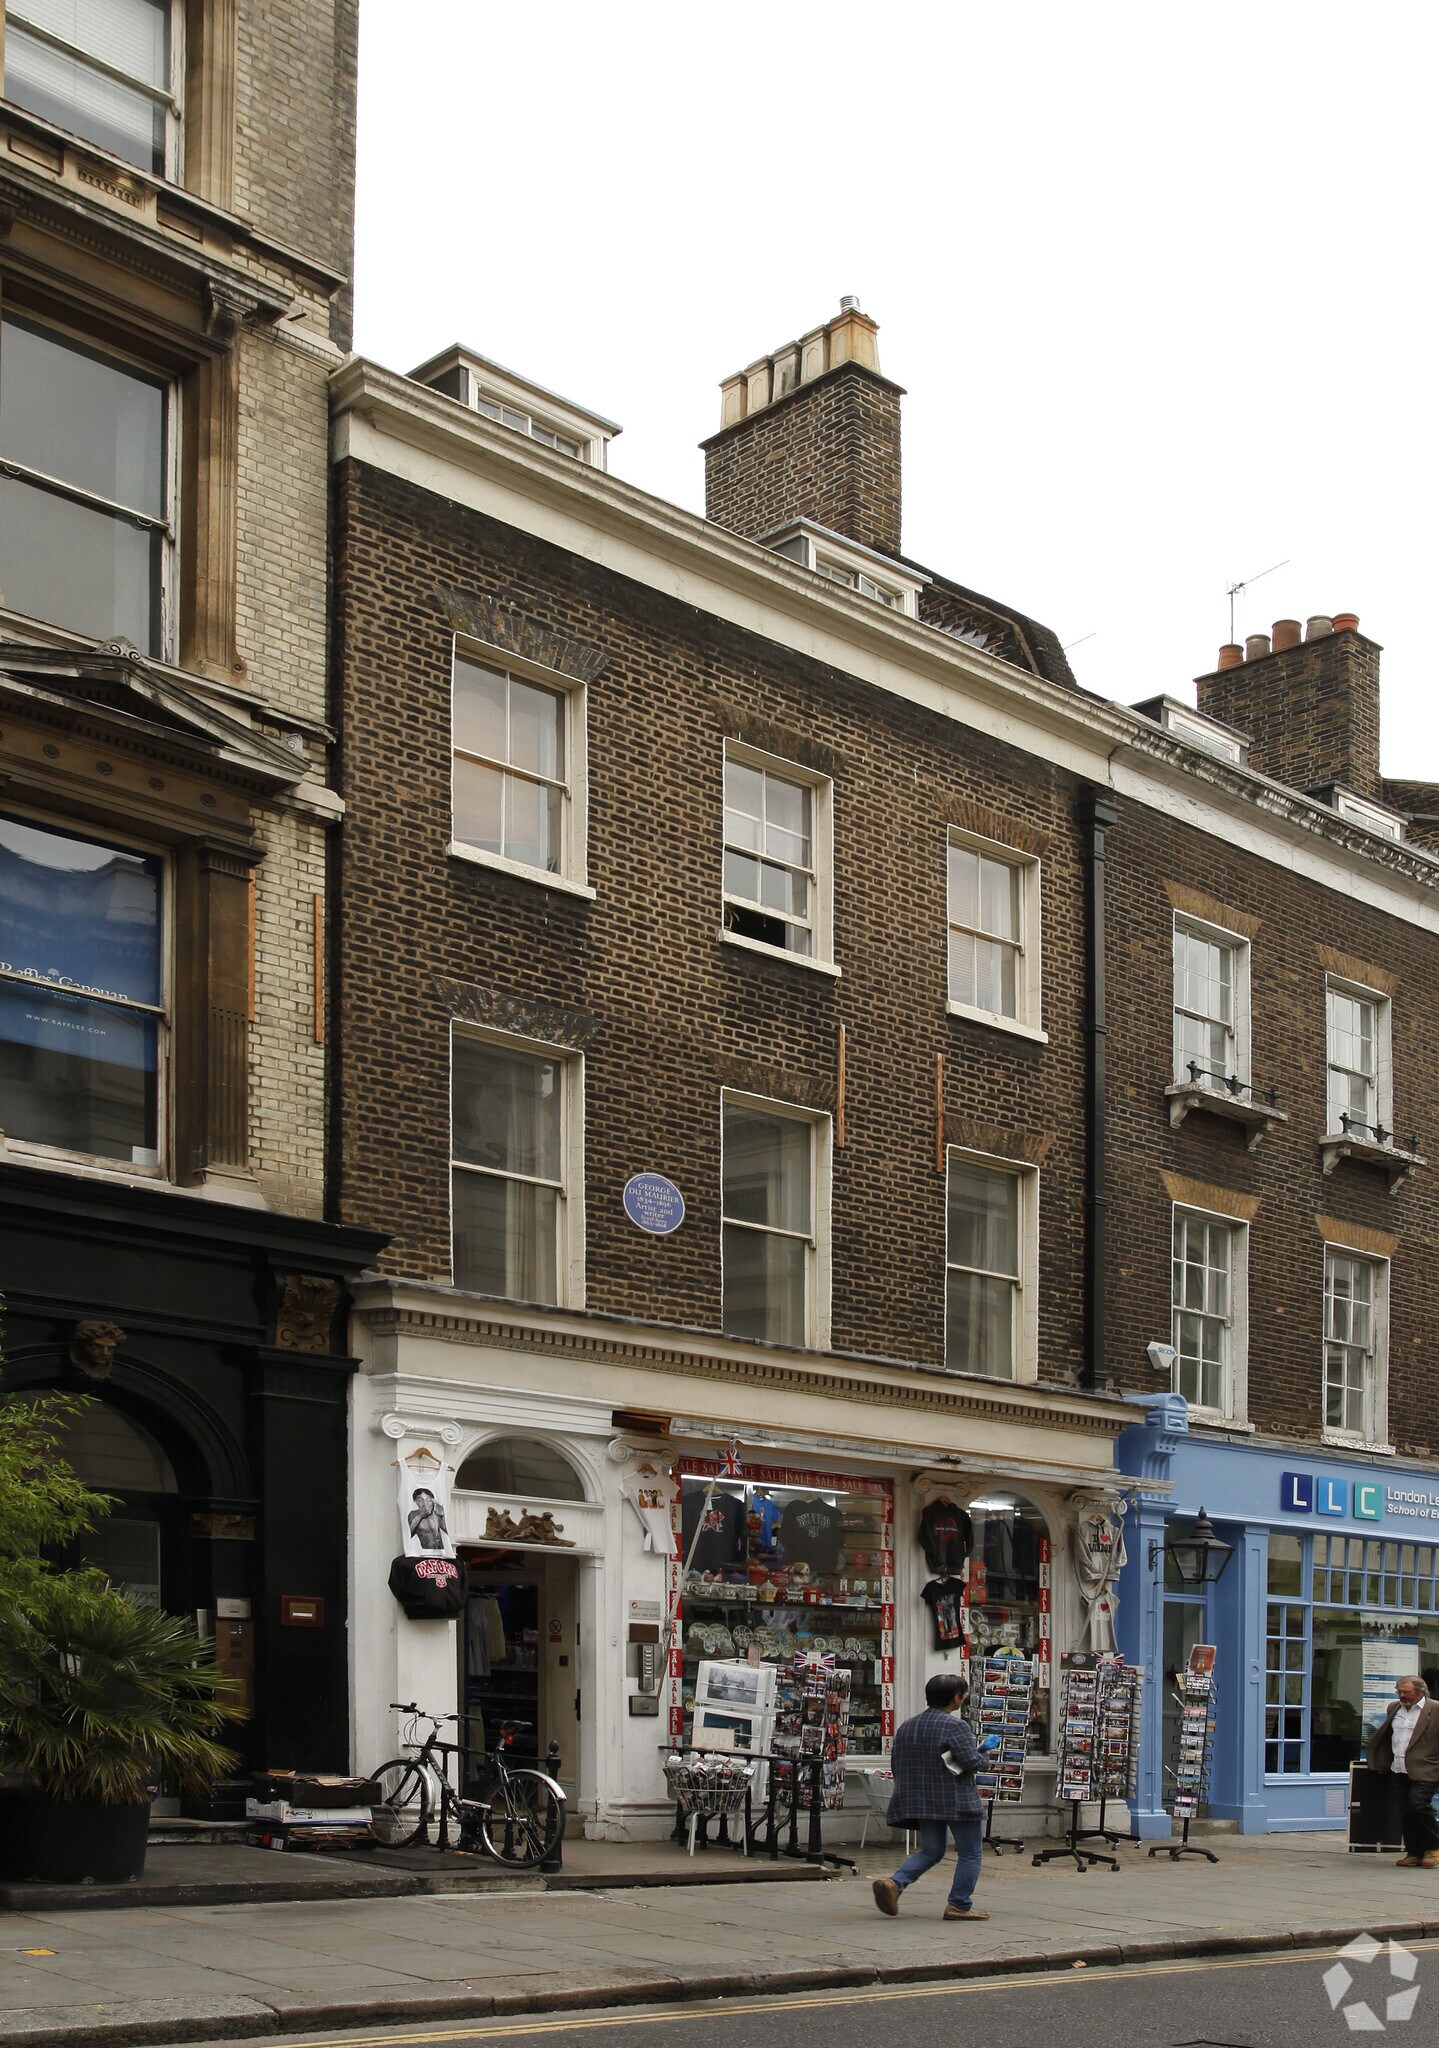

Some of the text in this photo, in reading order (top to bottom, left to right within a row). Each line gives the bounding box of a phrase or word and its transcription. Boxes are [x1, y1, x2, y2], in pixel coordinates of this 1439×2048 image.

[25, 1013, 107, 1036] WWW.RAFFLES.COM
[628, 1187, 680, 1204] DU MAURIER
[638, 1182, 671, 1195] GEORGE
[635, 1202, 673, 1216] Artist and
[643, 1210, 665, 1219] writer
[760, 1471, 784, 1482] SALE
[788, 1472, 811, 1484] SALE
[815, 1475, 838, 1487] SALE
[839, 1479, 864, 1491] SALE
[1387, 1486, 1427, 1505] London
[1387, 1504, 1419, 1517] School
[1420, 1507, 1430, 1518] of
[415, 1559, 458, 1579] OXFORD
[697, 1731, 729, 1748] 99p
